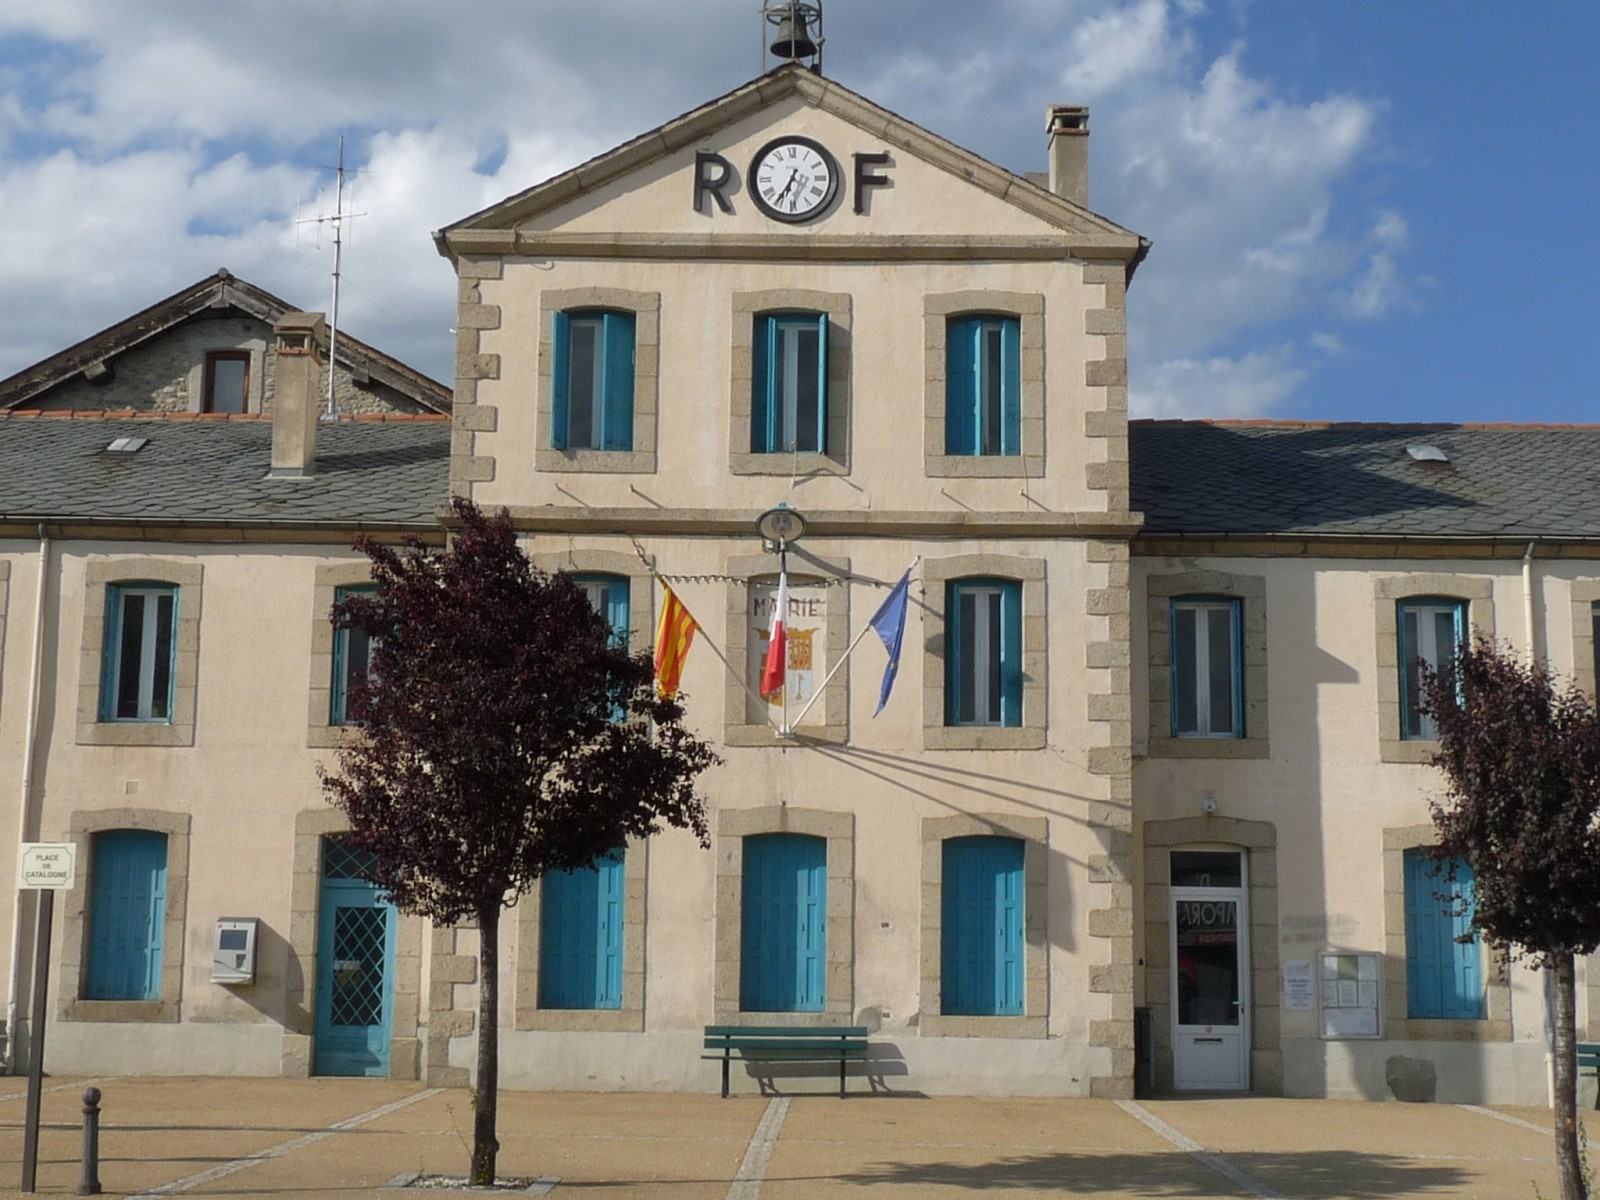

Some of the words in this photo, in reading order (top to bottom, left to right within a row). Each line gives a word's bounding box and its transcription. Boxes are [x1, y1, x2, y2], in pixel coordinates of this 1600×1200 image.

[693, 151, 731, 212] R
[853, 151, 889, 214] F
[754, 598, 817, 617] MARIE
